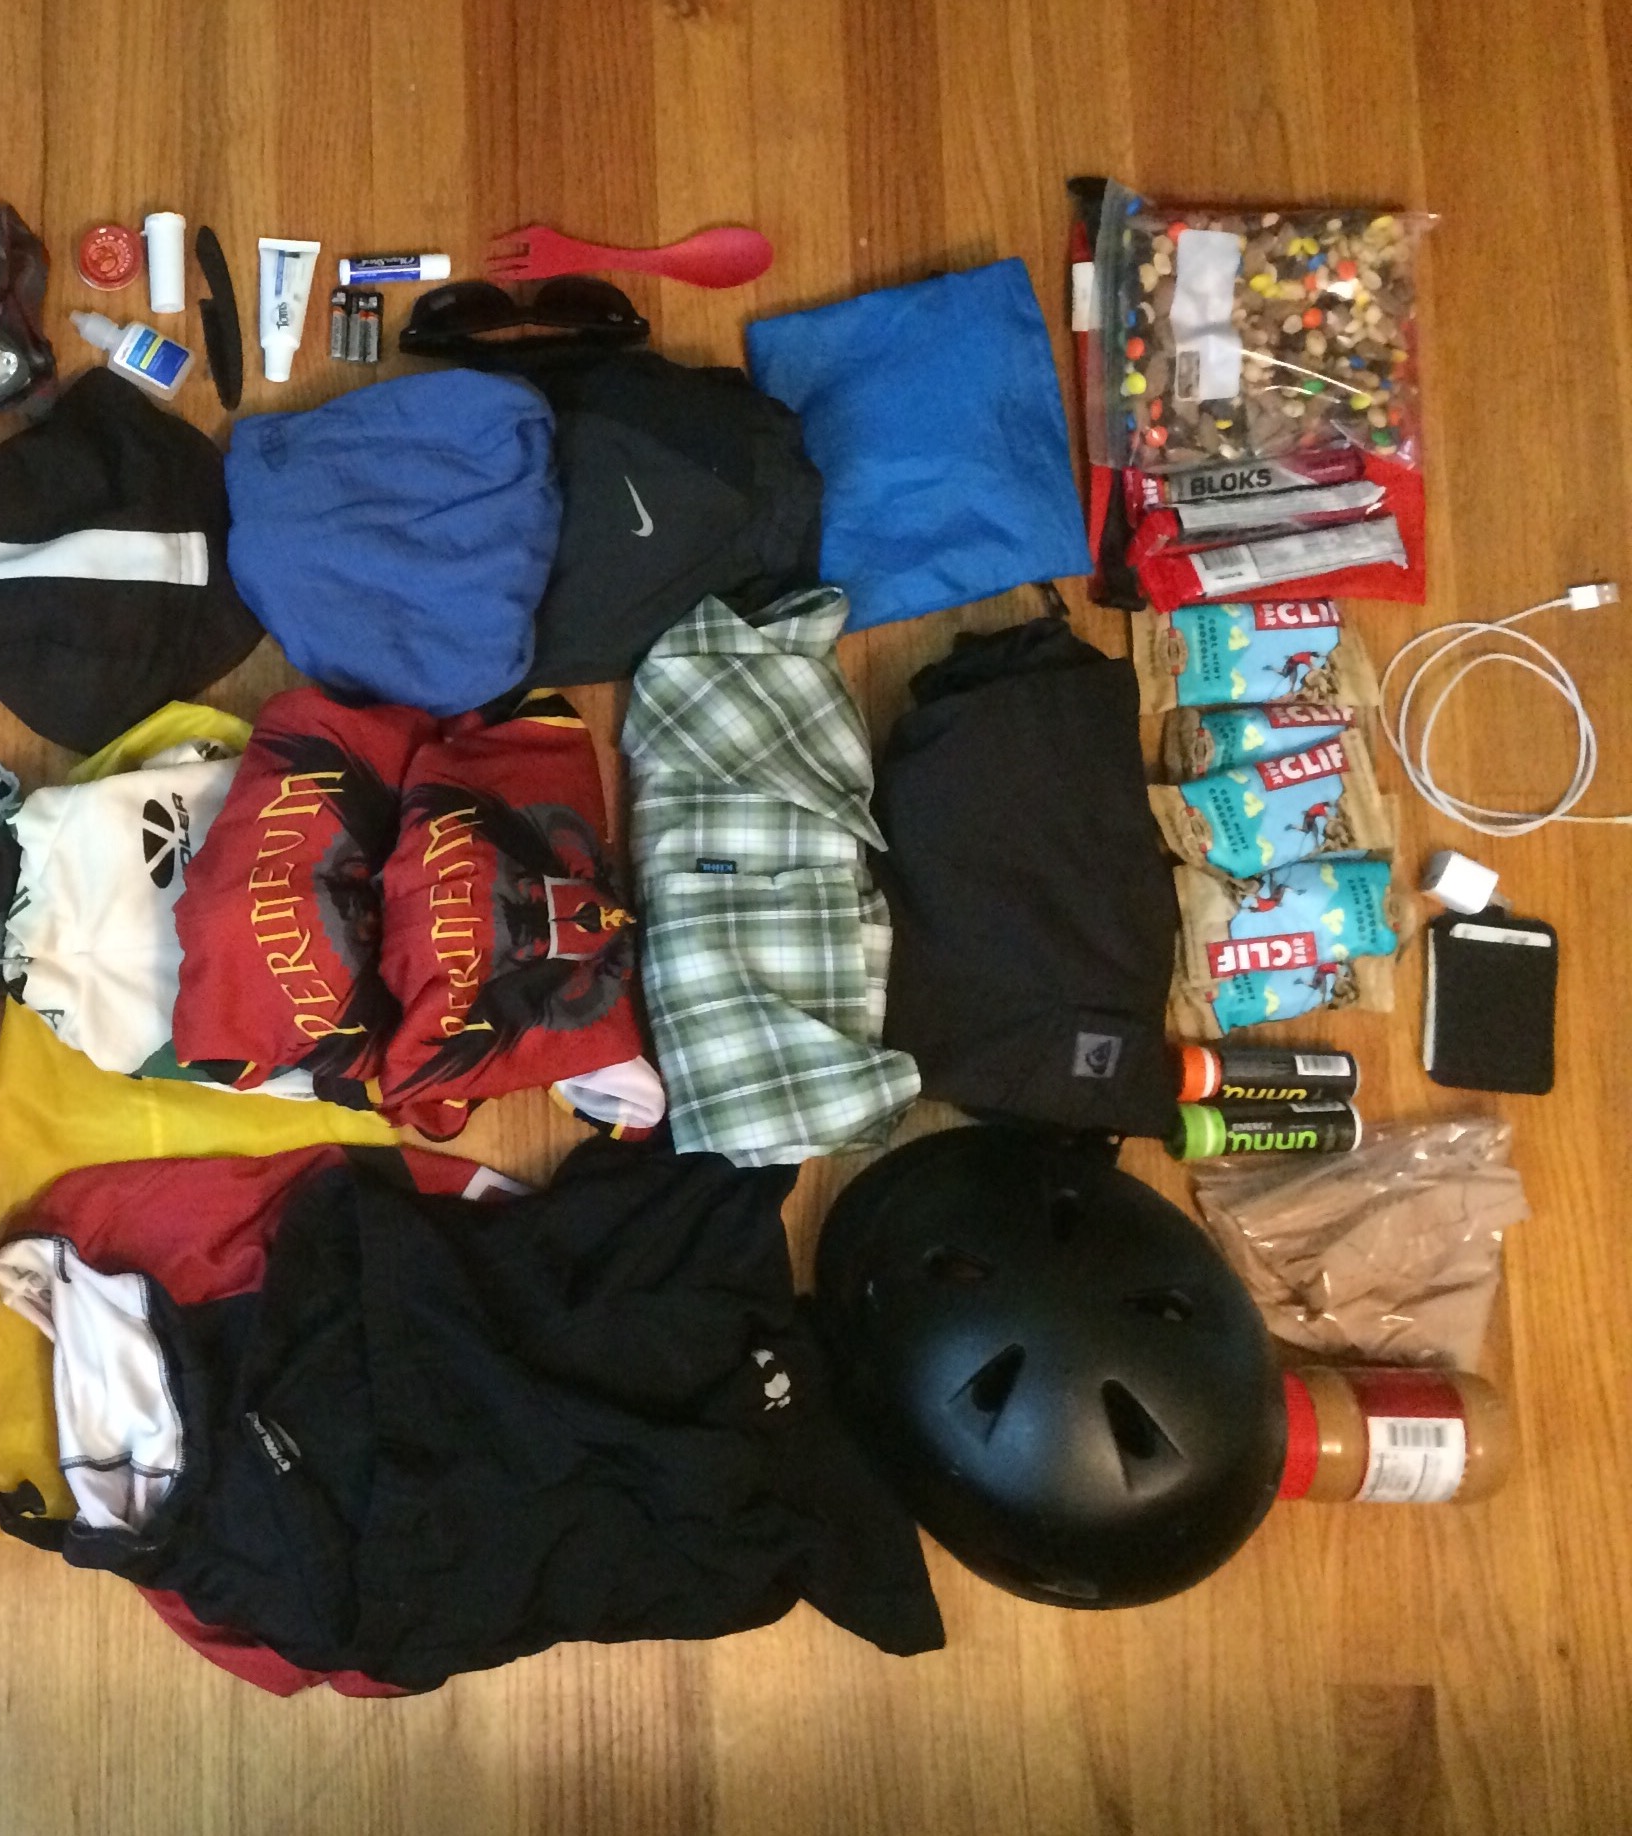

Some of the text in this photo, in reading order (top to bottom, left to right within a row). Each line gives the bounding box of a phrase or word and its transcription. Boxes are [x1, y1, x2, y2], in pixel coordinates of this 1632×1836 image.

[1189, 468, 1273, 496] BLOKS
[1279, 743, 1344, 781] CLIF
[1217, 939, 1293, 973] CLIF
[1222, 1084, 1308, 1100] nuun
[1227, 1130, 1318, 1152] nuun
